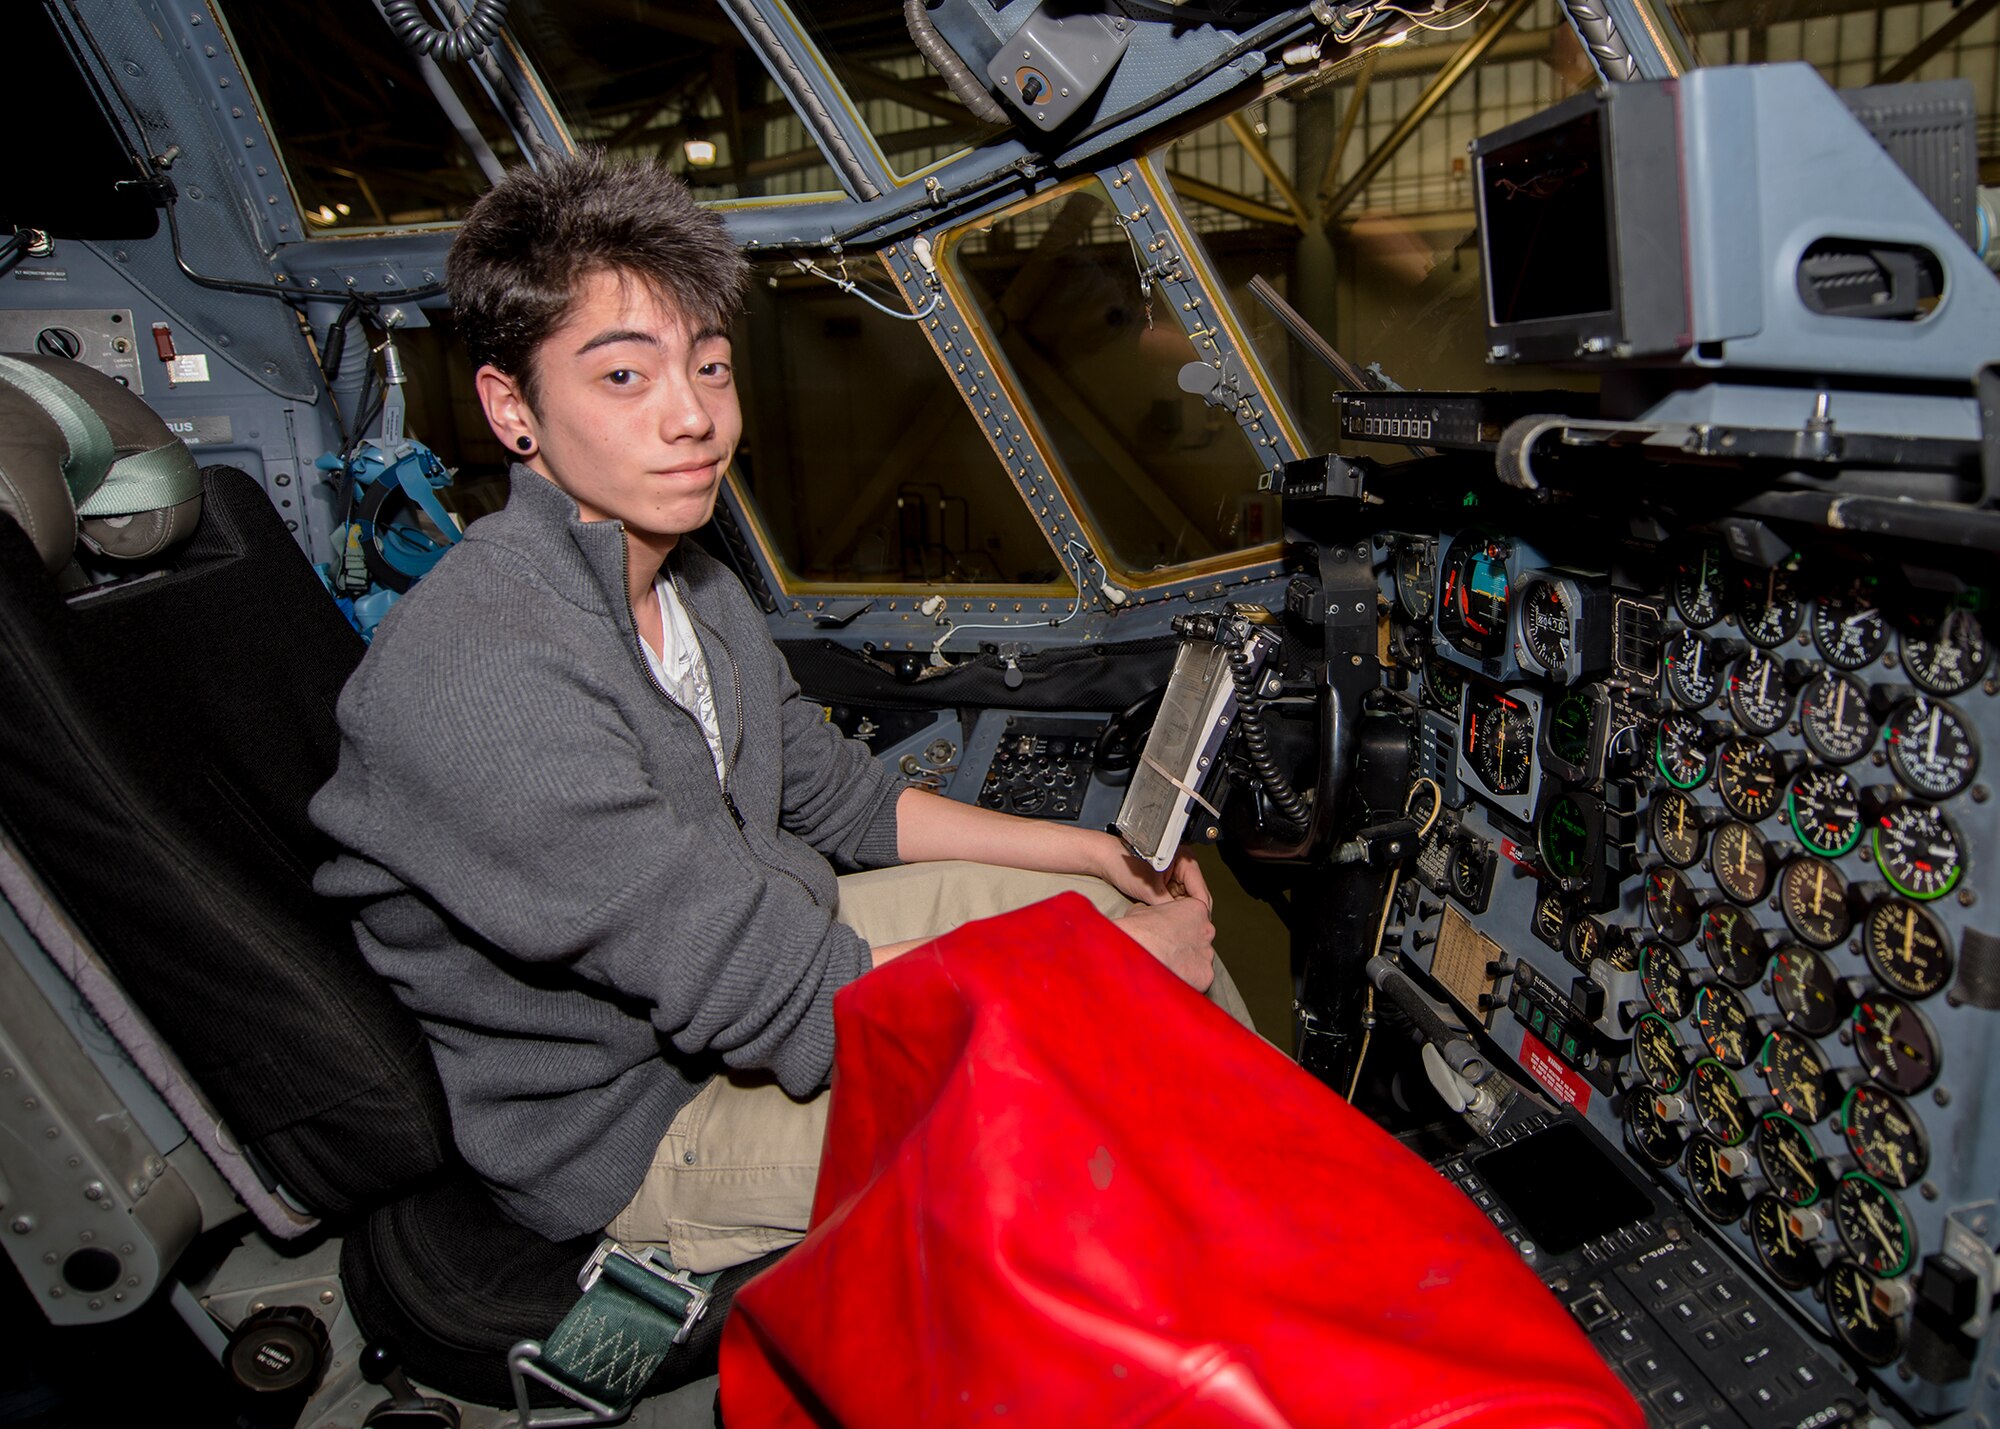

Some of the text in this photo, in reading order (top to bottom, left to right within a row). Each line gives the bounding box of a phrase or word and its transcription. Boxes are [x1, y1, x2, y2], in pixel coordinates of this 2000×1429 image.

[1557, 996, 1569, 1010] FUEL
[1533, 1010, 1544, 1032] 2
[1564, 1039, 1575, 1058] 4
[1640, 1242, 1675, 1263] DSPL
[261, 1345, 291, 1365] LUMBAR
